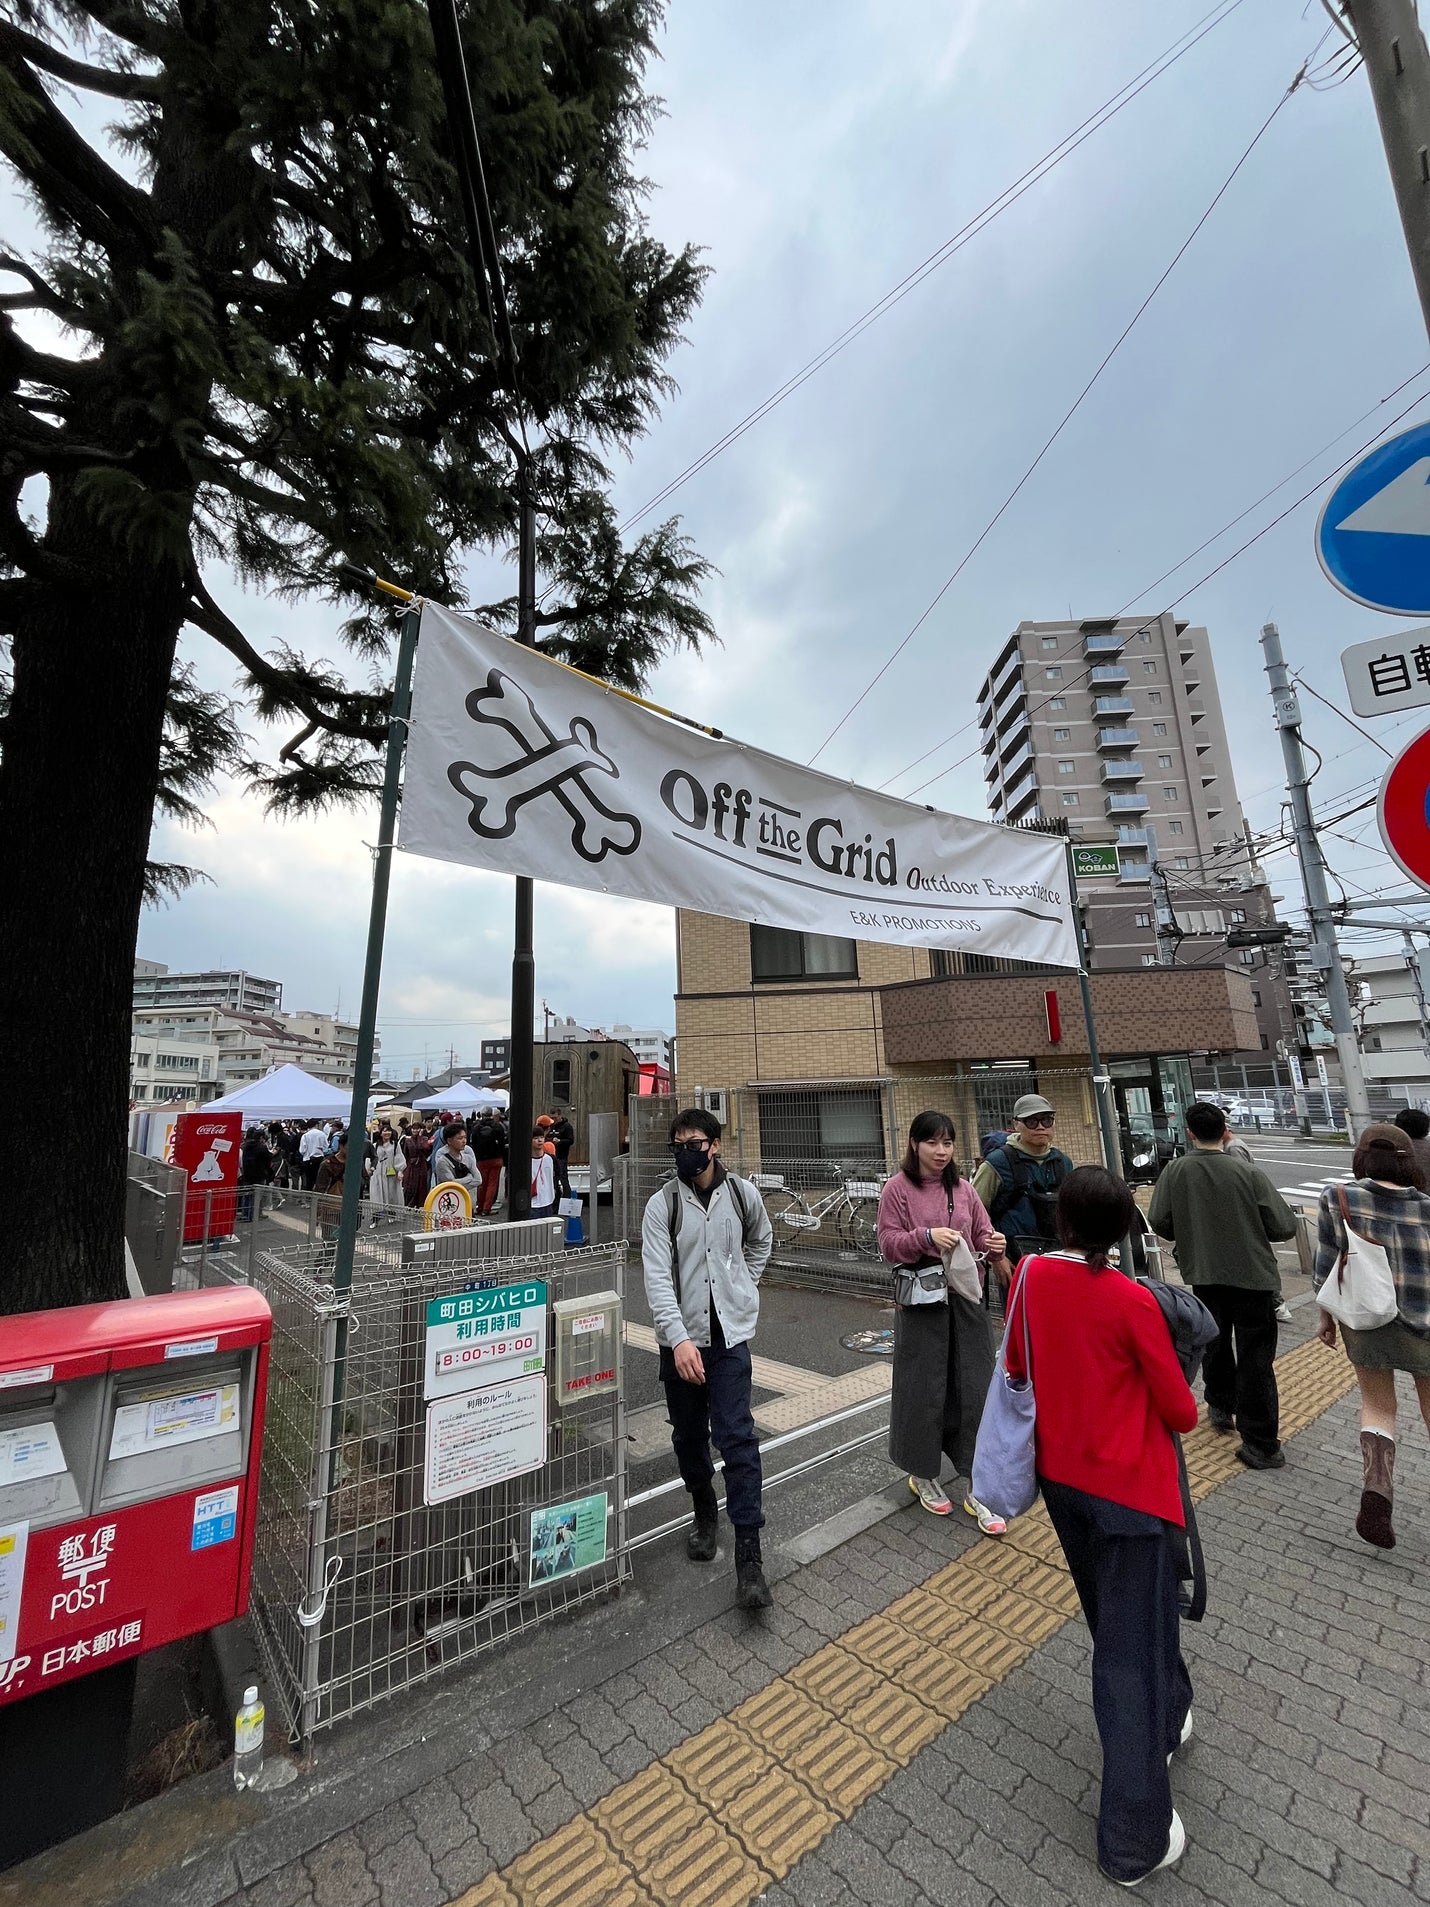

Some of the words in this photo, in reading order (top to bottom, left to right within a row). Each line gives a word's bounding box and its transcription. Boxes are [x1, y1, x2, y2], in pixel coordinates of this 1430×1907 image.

[659, 769, 752, 849] Off
[758, 811, 802, 853] the
[806, 817, 898, 887] Grid
[906, 866, 980, 895] Outdoor
[982, 878, 1061, 905] Experience
[1078, 863, 1116, 872] KOBAN
[850, 910, 882, 929] E&K
[882, 914, 982, 932] PROMOTIONS
[440, 1288, 537, 1319] 町田シバヒロ
[456, 1312, 521, 1340] 利用時間
[565, 1375, 592, 1391] TAKE
[594, 1369, 615, 1382] ONE
[467, 1390, 513, 1410] 利用のルール
[57, 1523, 117, 1568] 郵便
[50, 1578, 111, 1621] POST
[41, 1619, 142, 1676] 日本郵便
